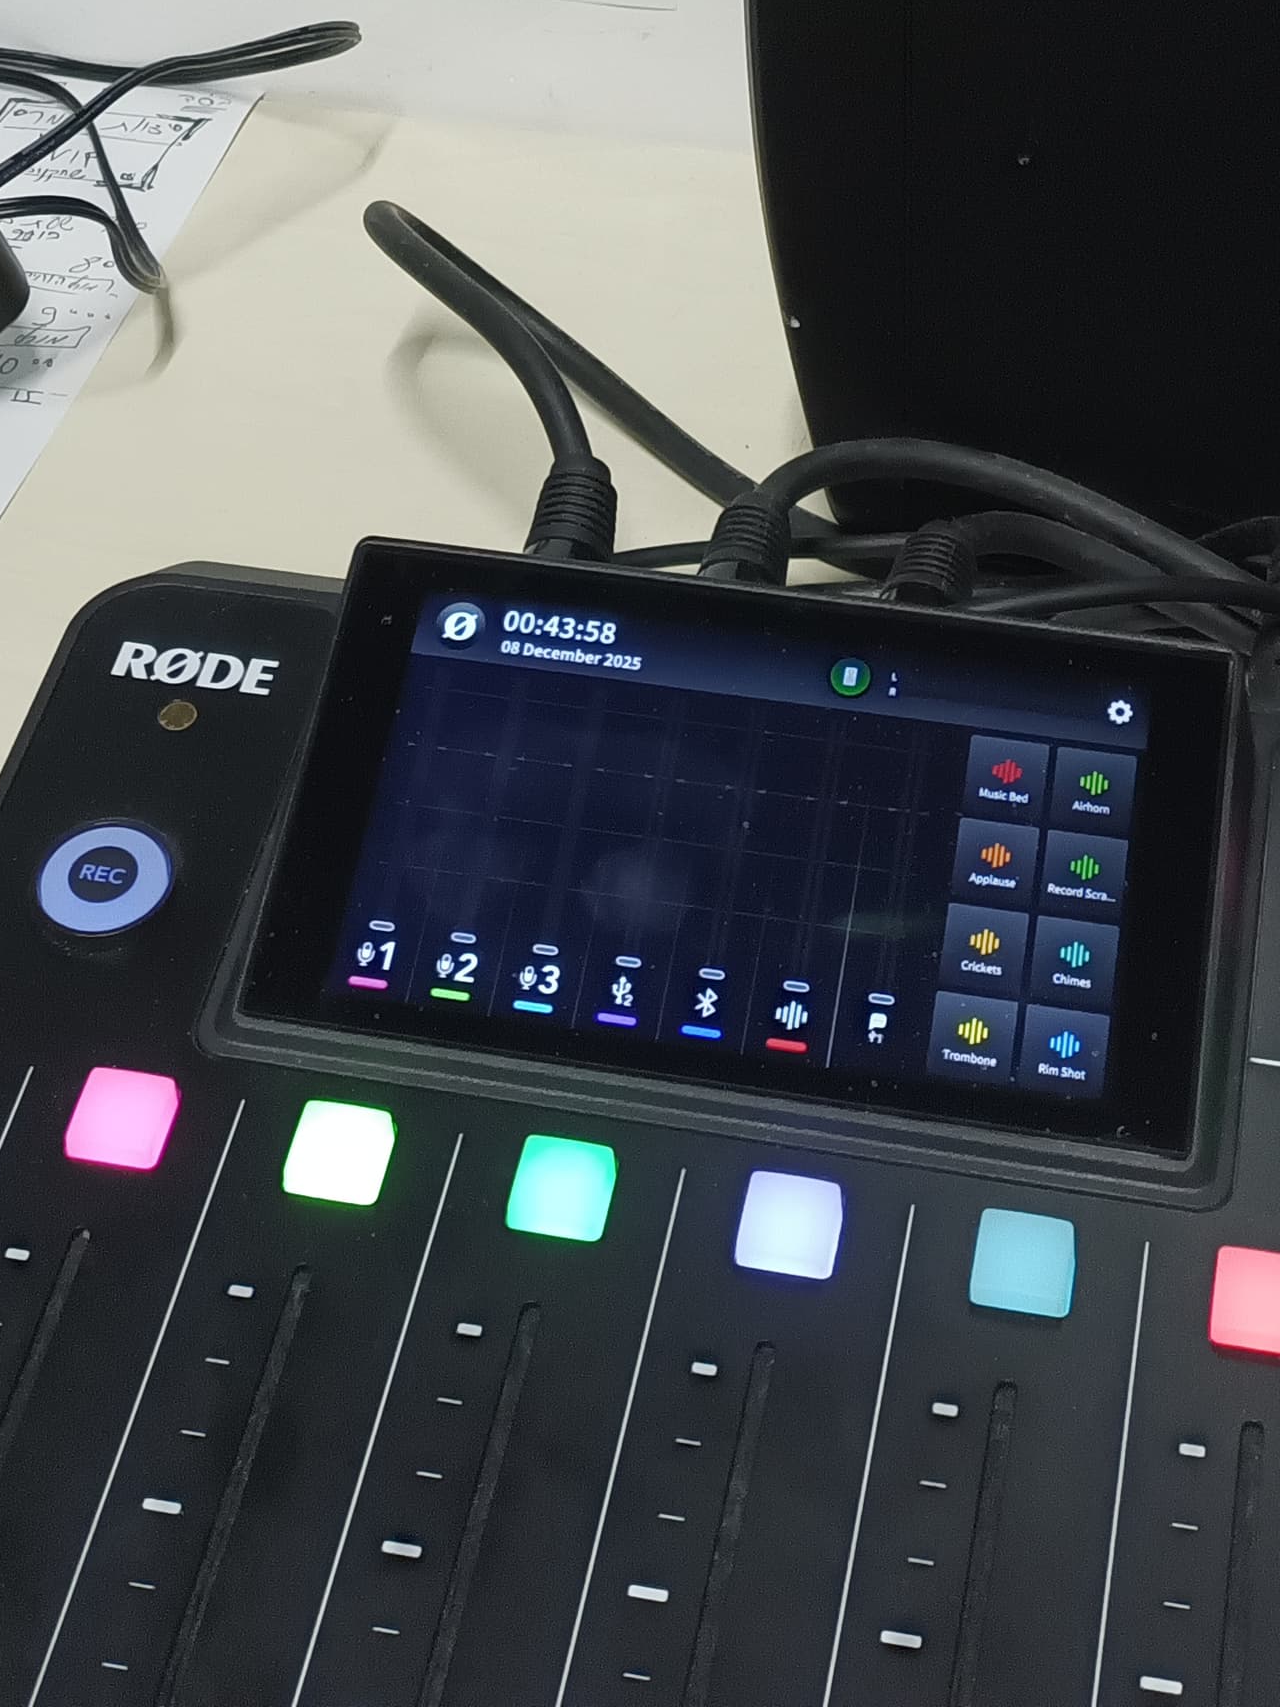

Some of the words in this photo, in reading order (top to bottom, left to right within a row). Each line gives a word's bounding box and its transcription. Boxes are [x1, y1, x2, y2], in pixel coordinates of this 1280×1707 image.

[503, 610, 618, 646] 00:43:58
[500, 639, 521, 655] 08
[522, 642, 602, 666] December
[603, 652, 643, 672] 2025
[110, 640, 280, 697] RØDE
[978, 787, 1007, 803] Music
[1008, 790, 1030, 804] Bed
[1072, 800, 1111, 816] Airhorn
[79, 863, 128, 886] REC
[968, 872, 1017, 889] Applause
[1047, 883, 1083, 899] Record
[377, 940, 396, 972] 1
[452, 952, 479, 985] 2
[960, 960, 1003, 976] Crickets
[536, 963, 561, 996] 3
[1052, 972, 1092, 989] Chimes
[942, 1048, 998, 1069] Trombone
[1038, 1062, 1060, 1079] Rim
[1061, 1065, 1087, 1081] Shot
